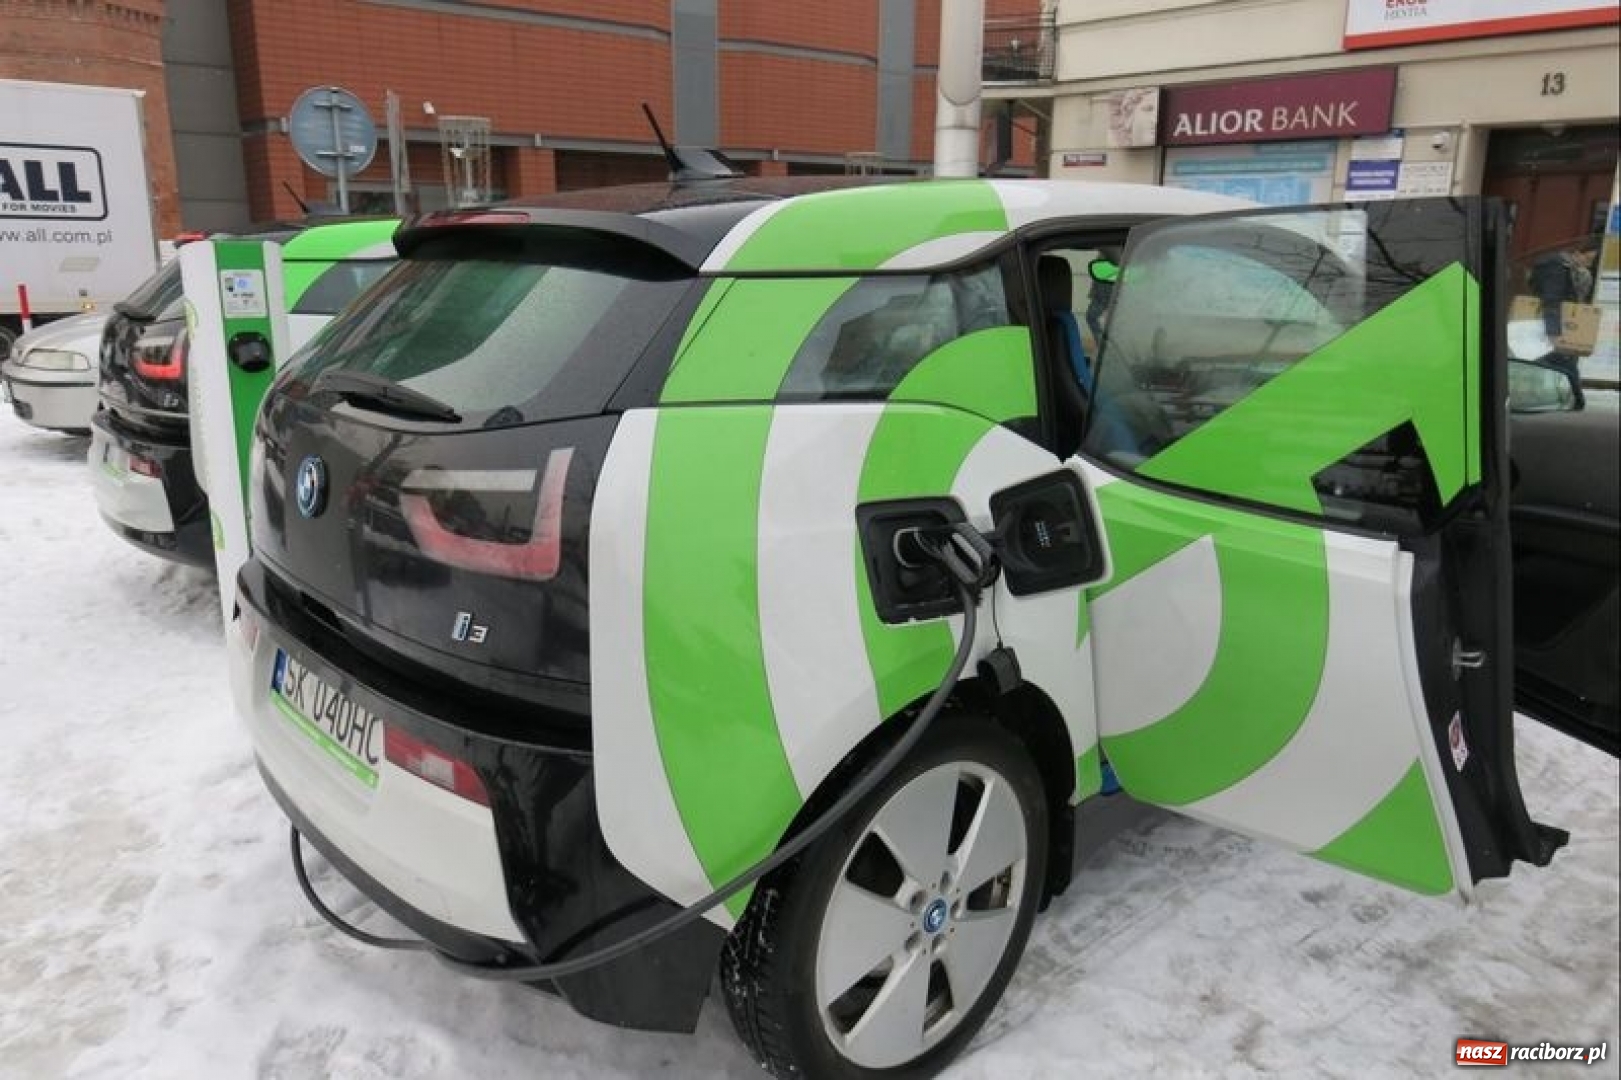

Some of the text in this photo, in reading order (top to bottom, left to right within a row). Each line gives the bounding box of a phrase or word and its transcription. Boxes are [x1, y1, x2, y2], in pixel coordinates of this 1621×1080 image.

[1540, 72, 1565, 97] 13
[1173, 101, 1359, 137] ALIOR BANK
[2, 203, 77, 214] FOR MOVIES
[452, 611, 488, 643] i3
[284, 656, 308, 711] SK
